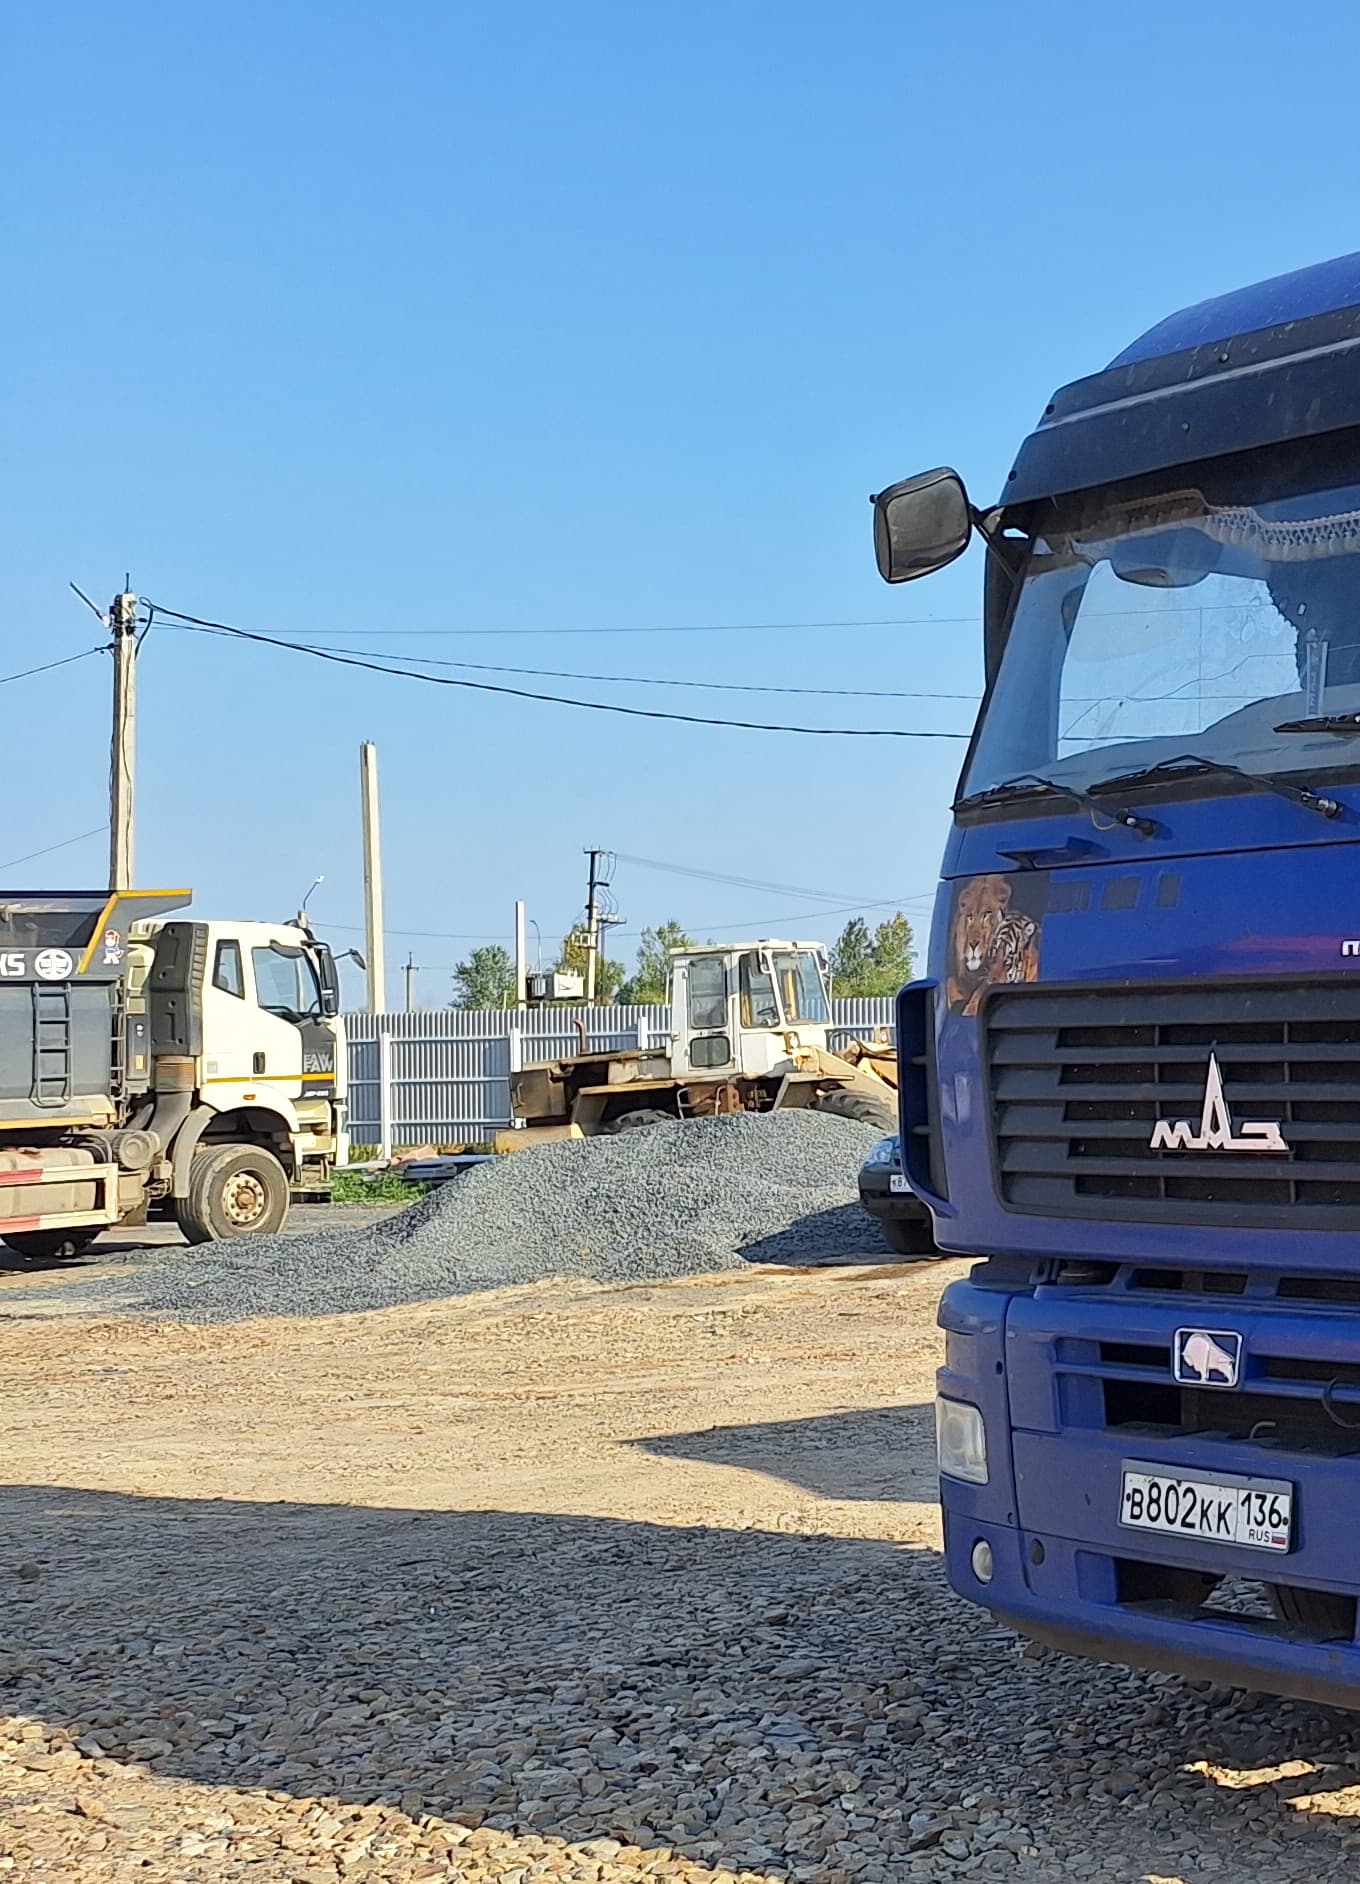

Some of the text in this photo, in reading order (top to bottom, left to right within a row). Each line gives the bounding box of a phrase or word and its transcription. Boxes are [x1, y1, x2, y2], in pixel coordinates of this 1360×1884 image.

[1150, 1051, 1290, 1150] МАЗ
[1129, 1481, 1283, 1535] В802КК 136
[1248, 1528, 1271, 1543] RUS
